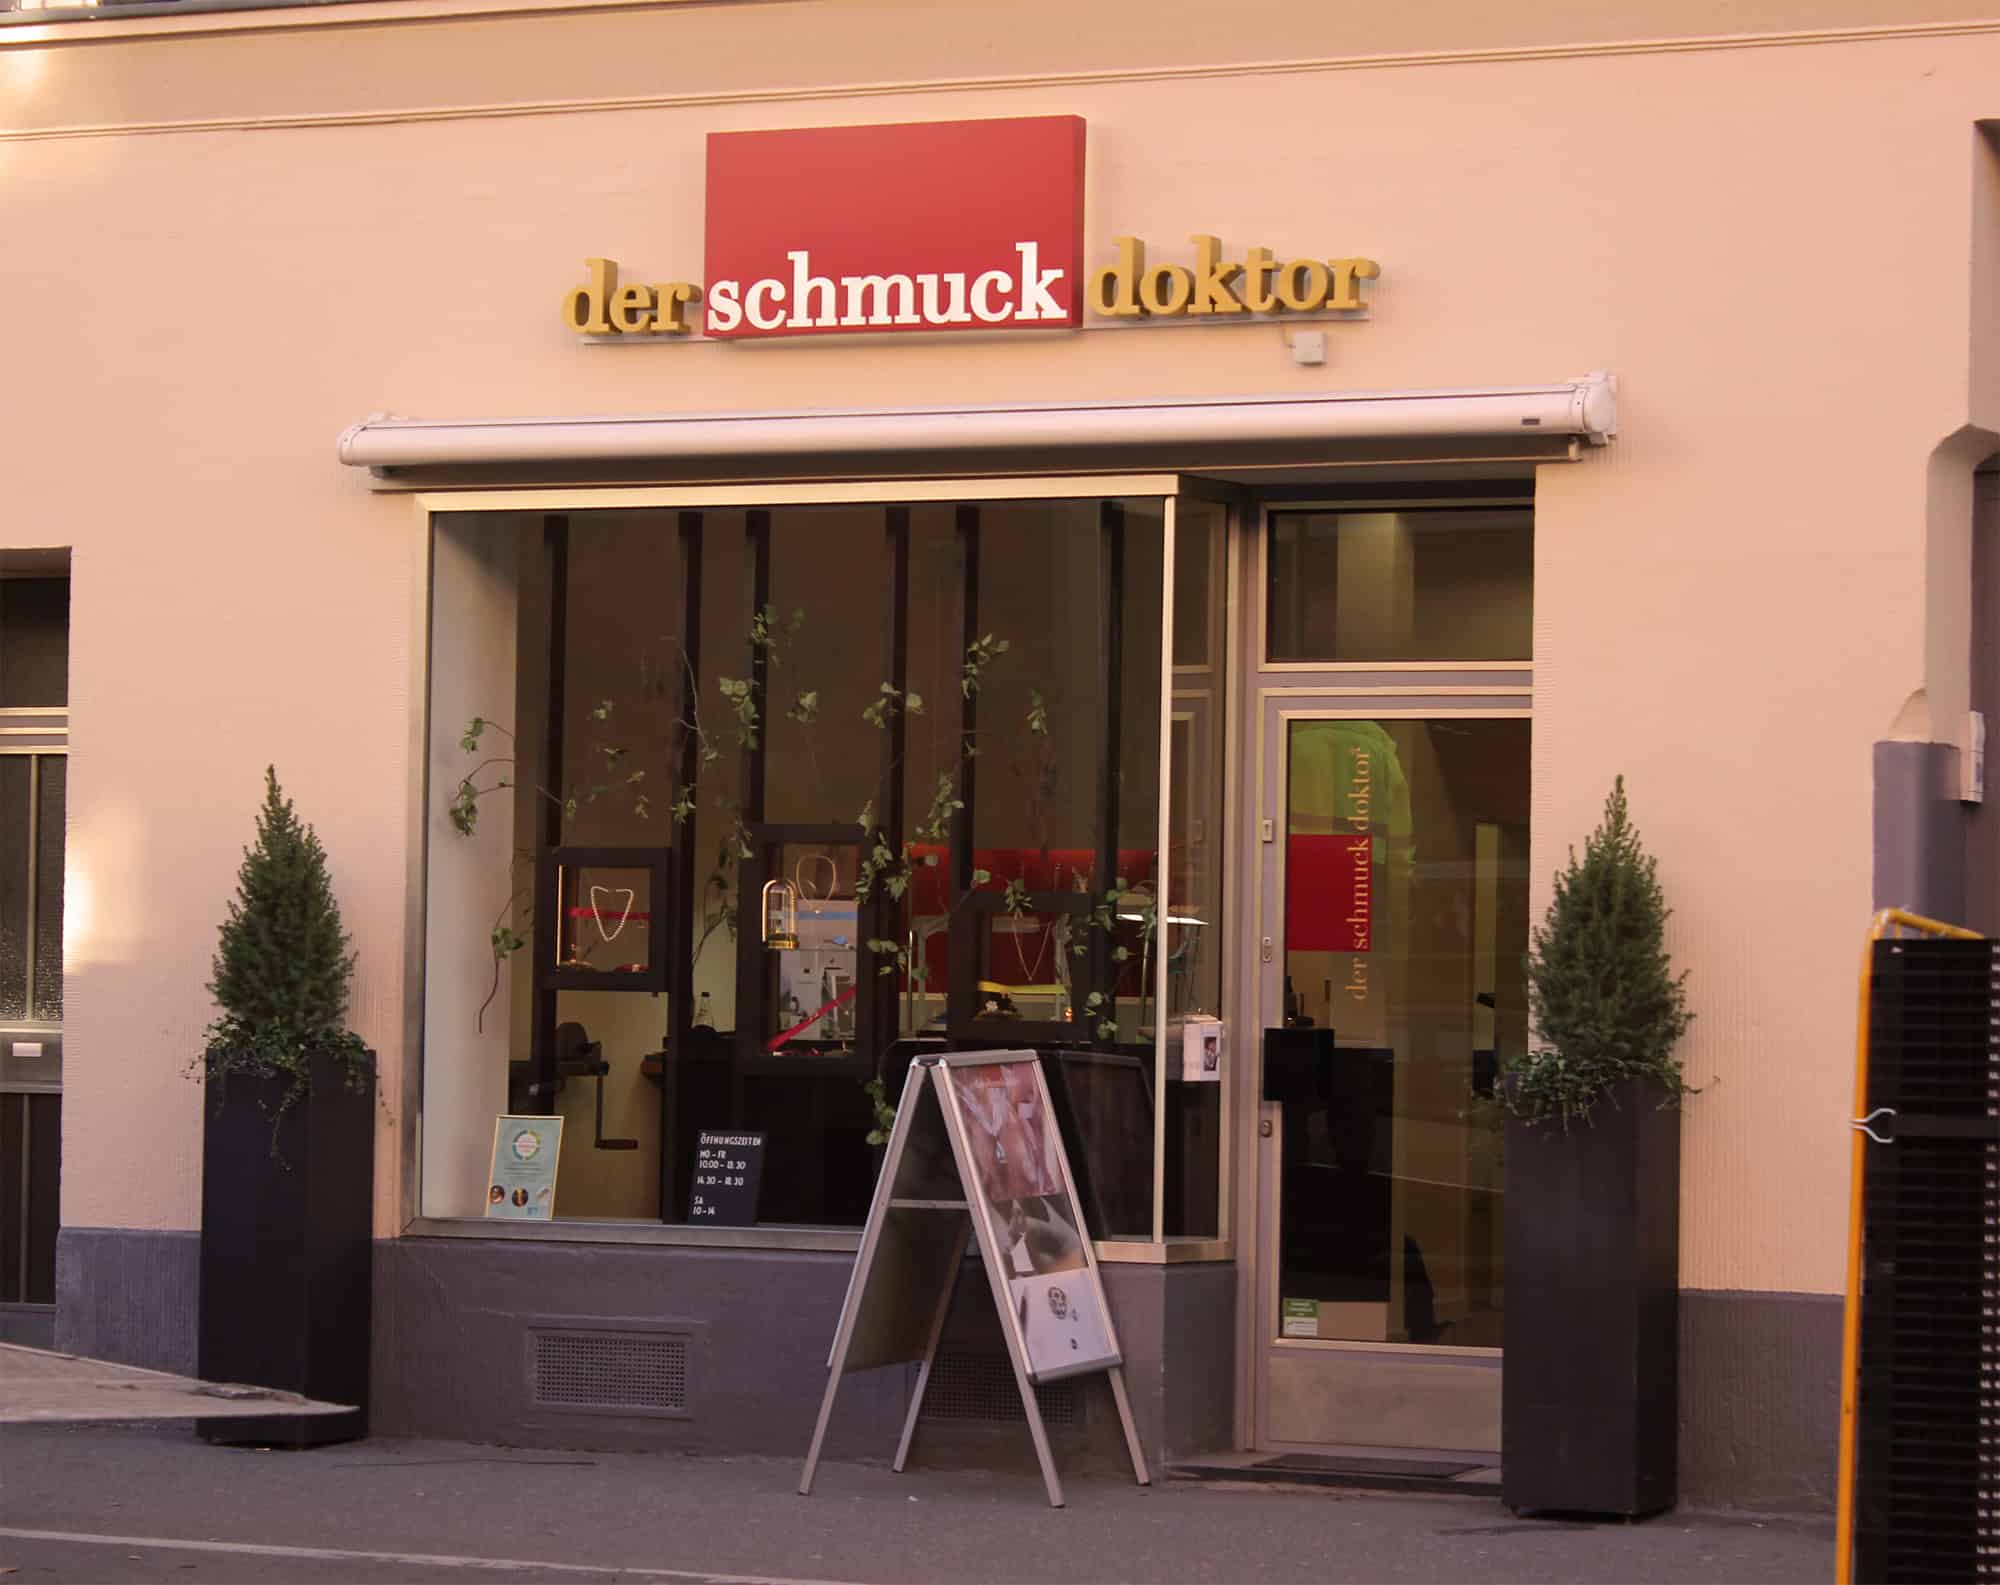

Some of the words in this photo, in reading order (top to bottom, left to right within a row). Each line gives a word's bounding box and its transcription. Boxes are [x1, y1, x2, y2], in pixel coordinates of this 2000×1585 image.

[562, 259, 703, 337] der
[706, 242, 1066, 331] schmuck
[1087, 234, 1381, 318] doktor
[1346, 746, 1370, 832] doktor
[1346, 837, 1369, 950] schmuck
[1344, 957, 1368, 1000] der
[700, 1132, 761, 1145] ÖFFNUNGSZEITEN
